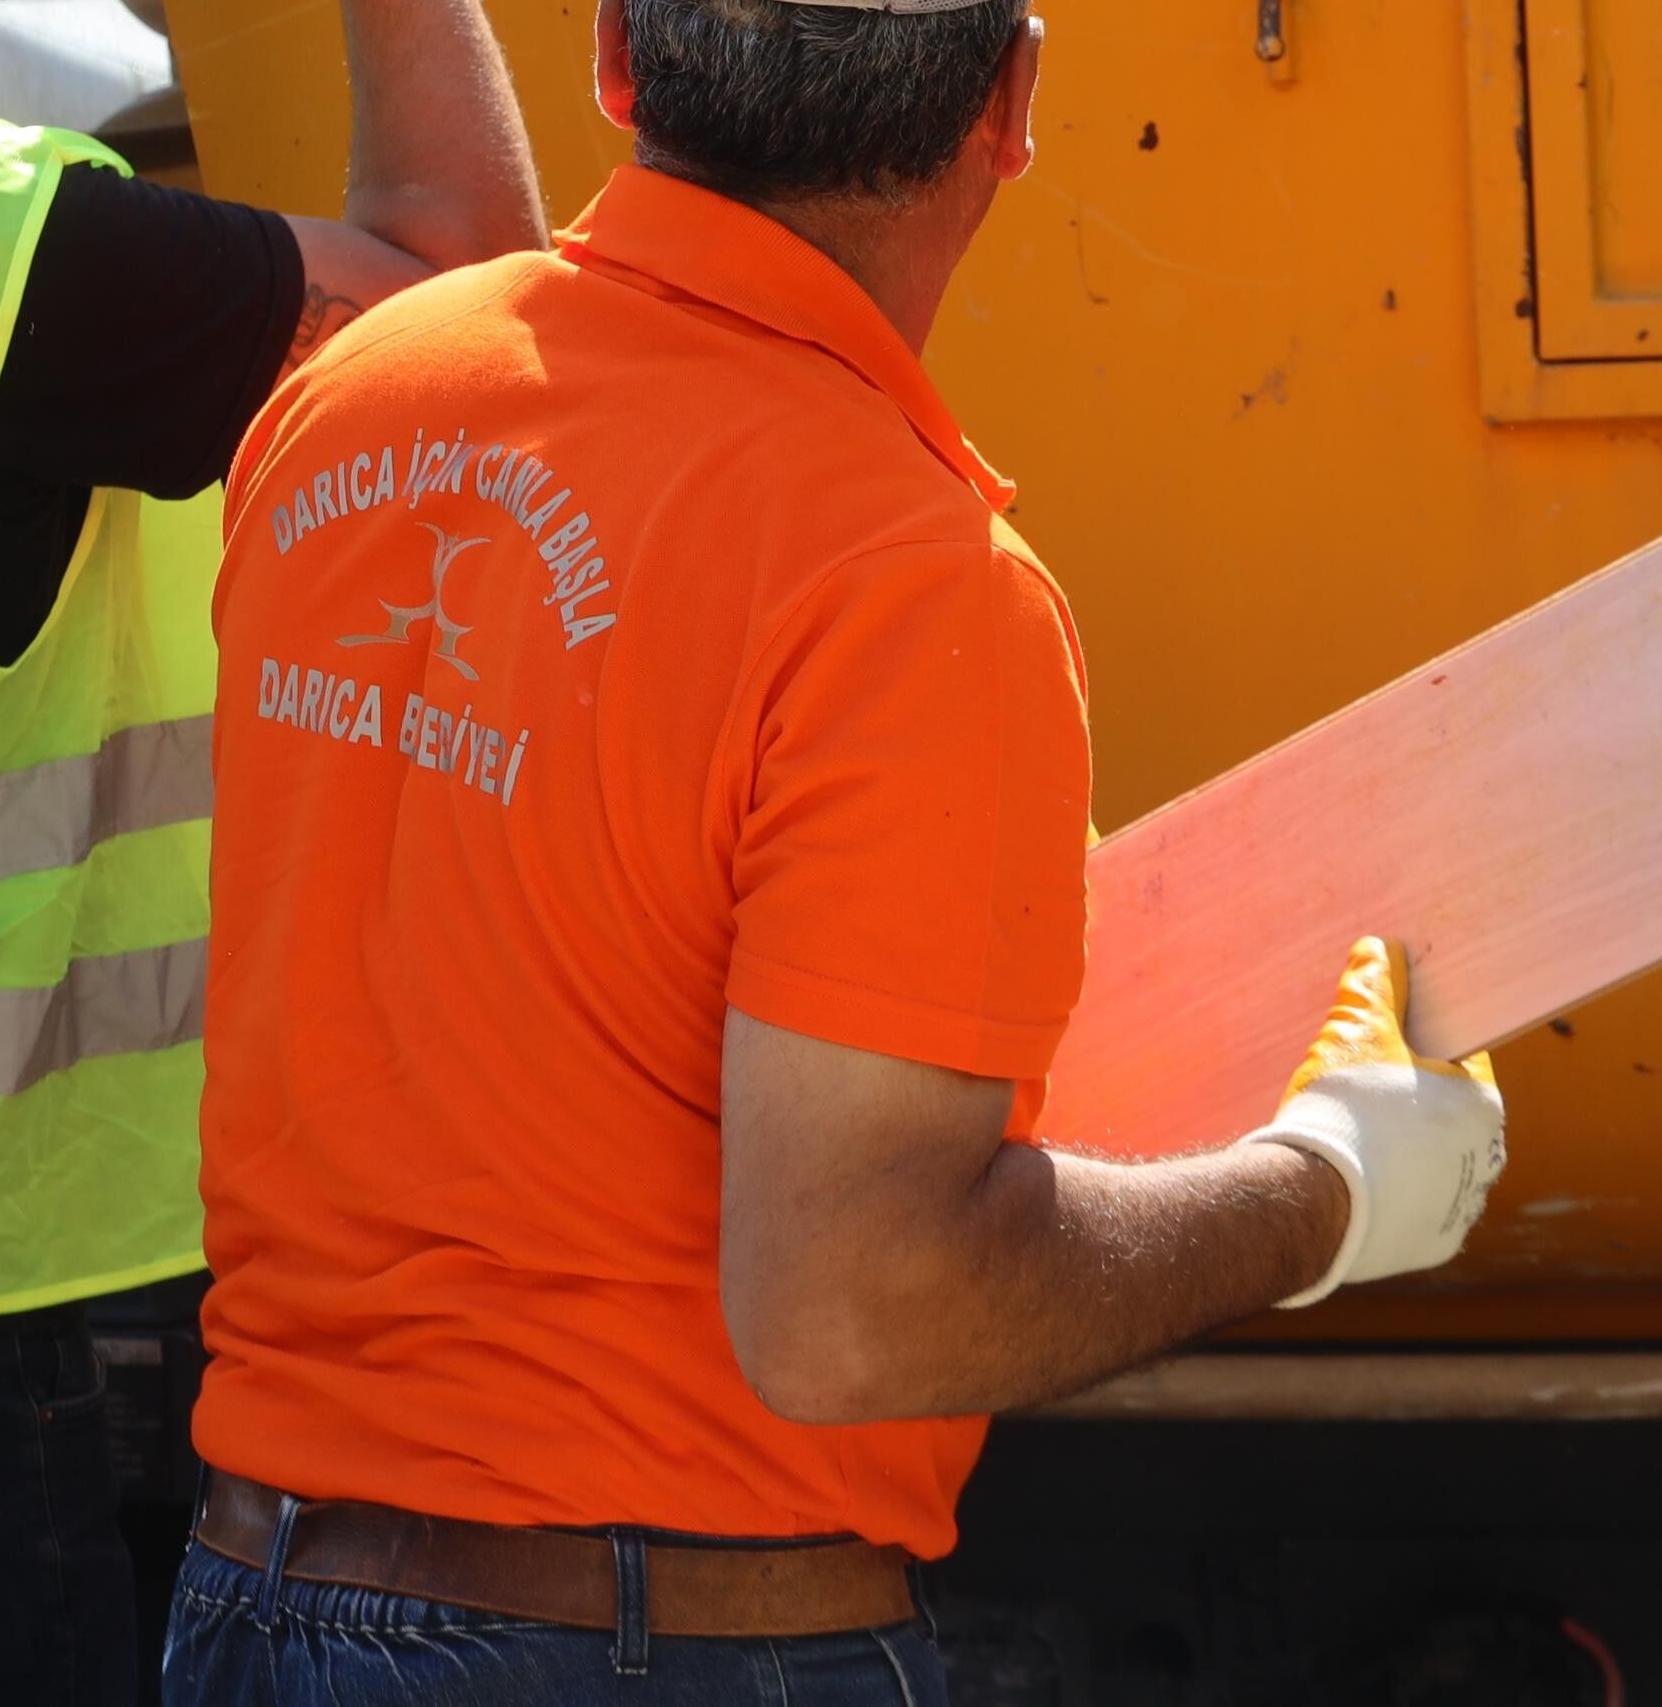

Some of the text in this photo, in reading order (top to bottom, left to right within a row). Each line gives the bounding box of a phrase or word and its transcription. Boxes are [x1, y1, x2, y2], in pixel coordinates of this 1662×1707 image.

[272, 446, 396, 556] DARICA
[476, 443, 571, 541] CANLA
[538, 511, 617, 651] BAŞLA
[258, 657, 382, 747] DARICA
